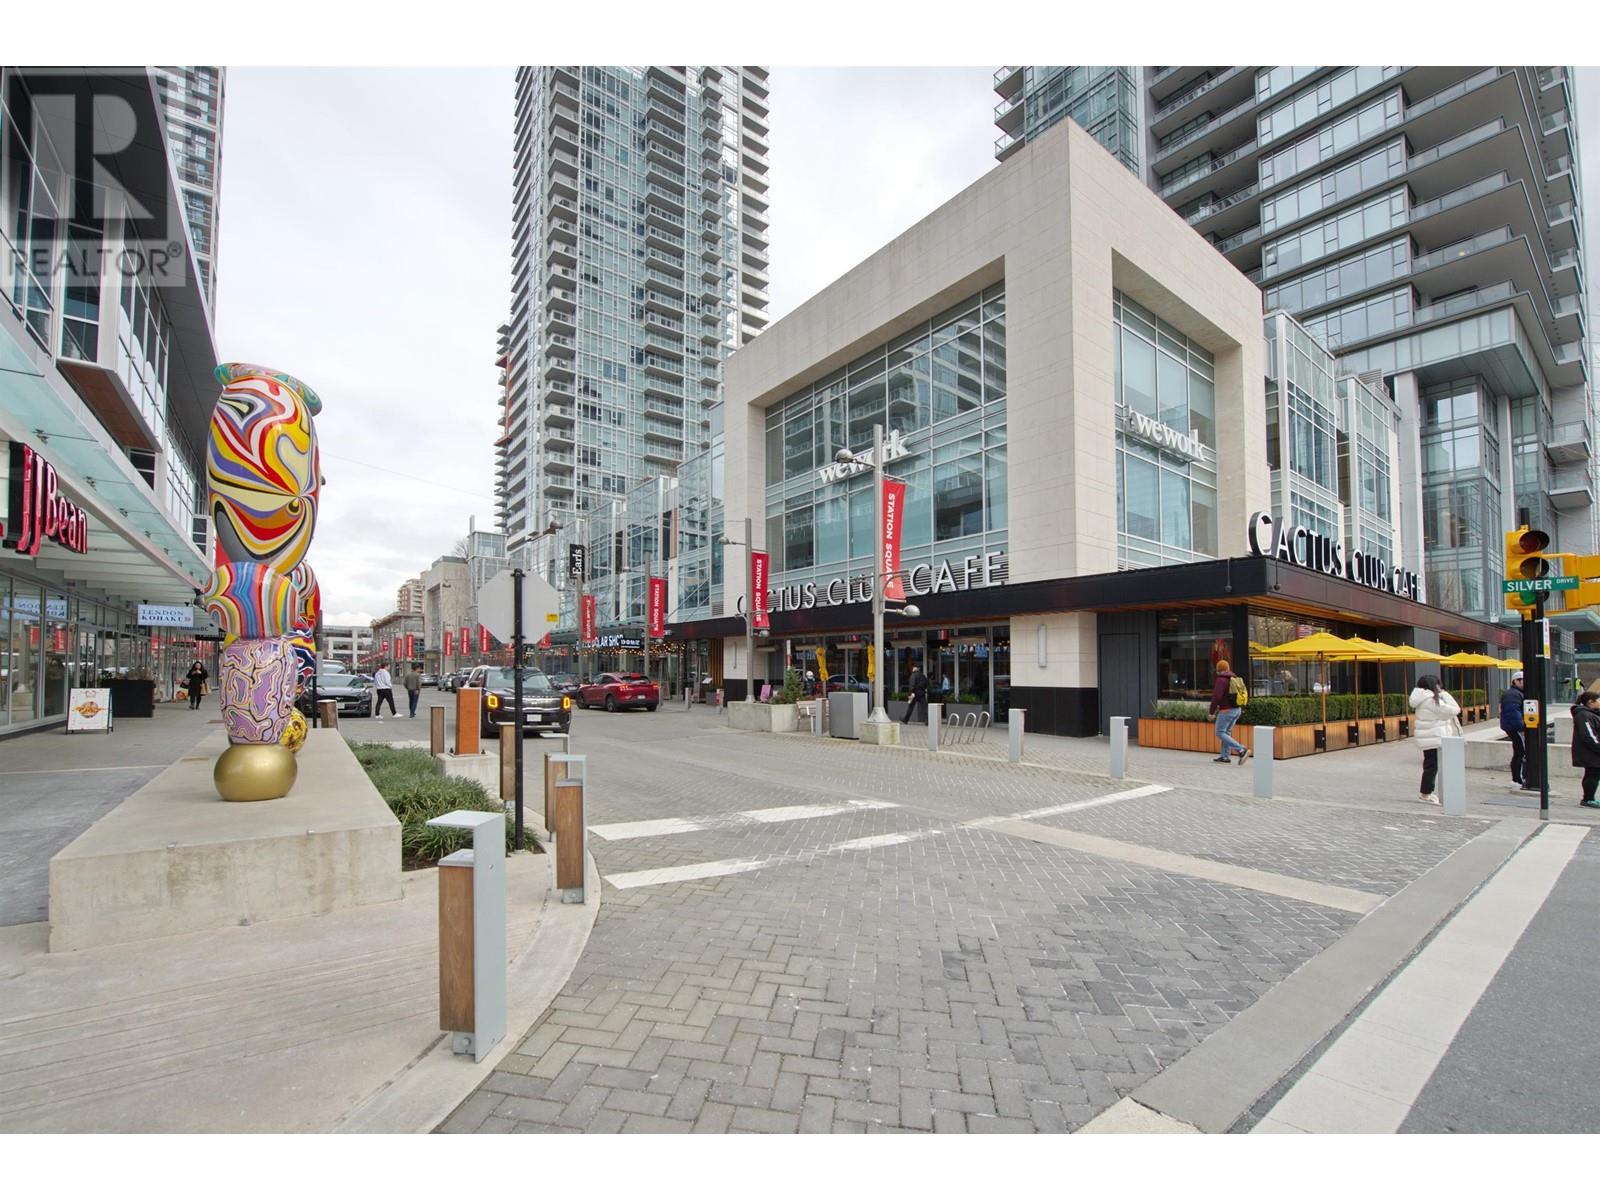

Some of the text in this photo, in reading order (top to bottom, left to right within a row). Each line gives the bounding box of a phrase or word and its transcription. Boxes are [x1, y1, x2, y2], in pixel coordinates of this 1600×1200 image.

[819, 429, 911, 483] wewrk
[1129, 405, 1206, 461] wework
[886, 493, 896, 539] STATION
[572, 549, 582, 575] Earls
[1249, 511, 1342, 577] CACTUS
[1350, 548, 1387, 591] CLUB
[736, 550, 1005, 614] CCTUS CLU CAFE
[1507, 580, 1552, 591] SILVER
